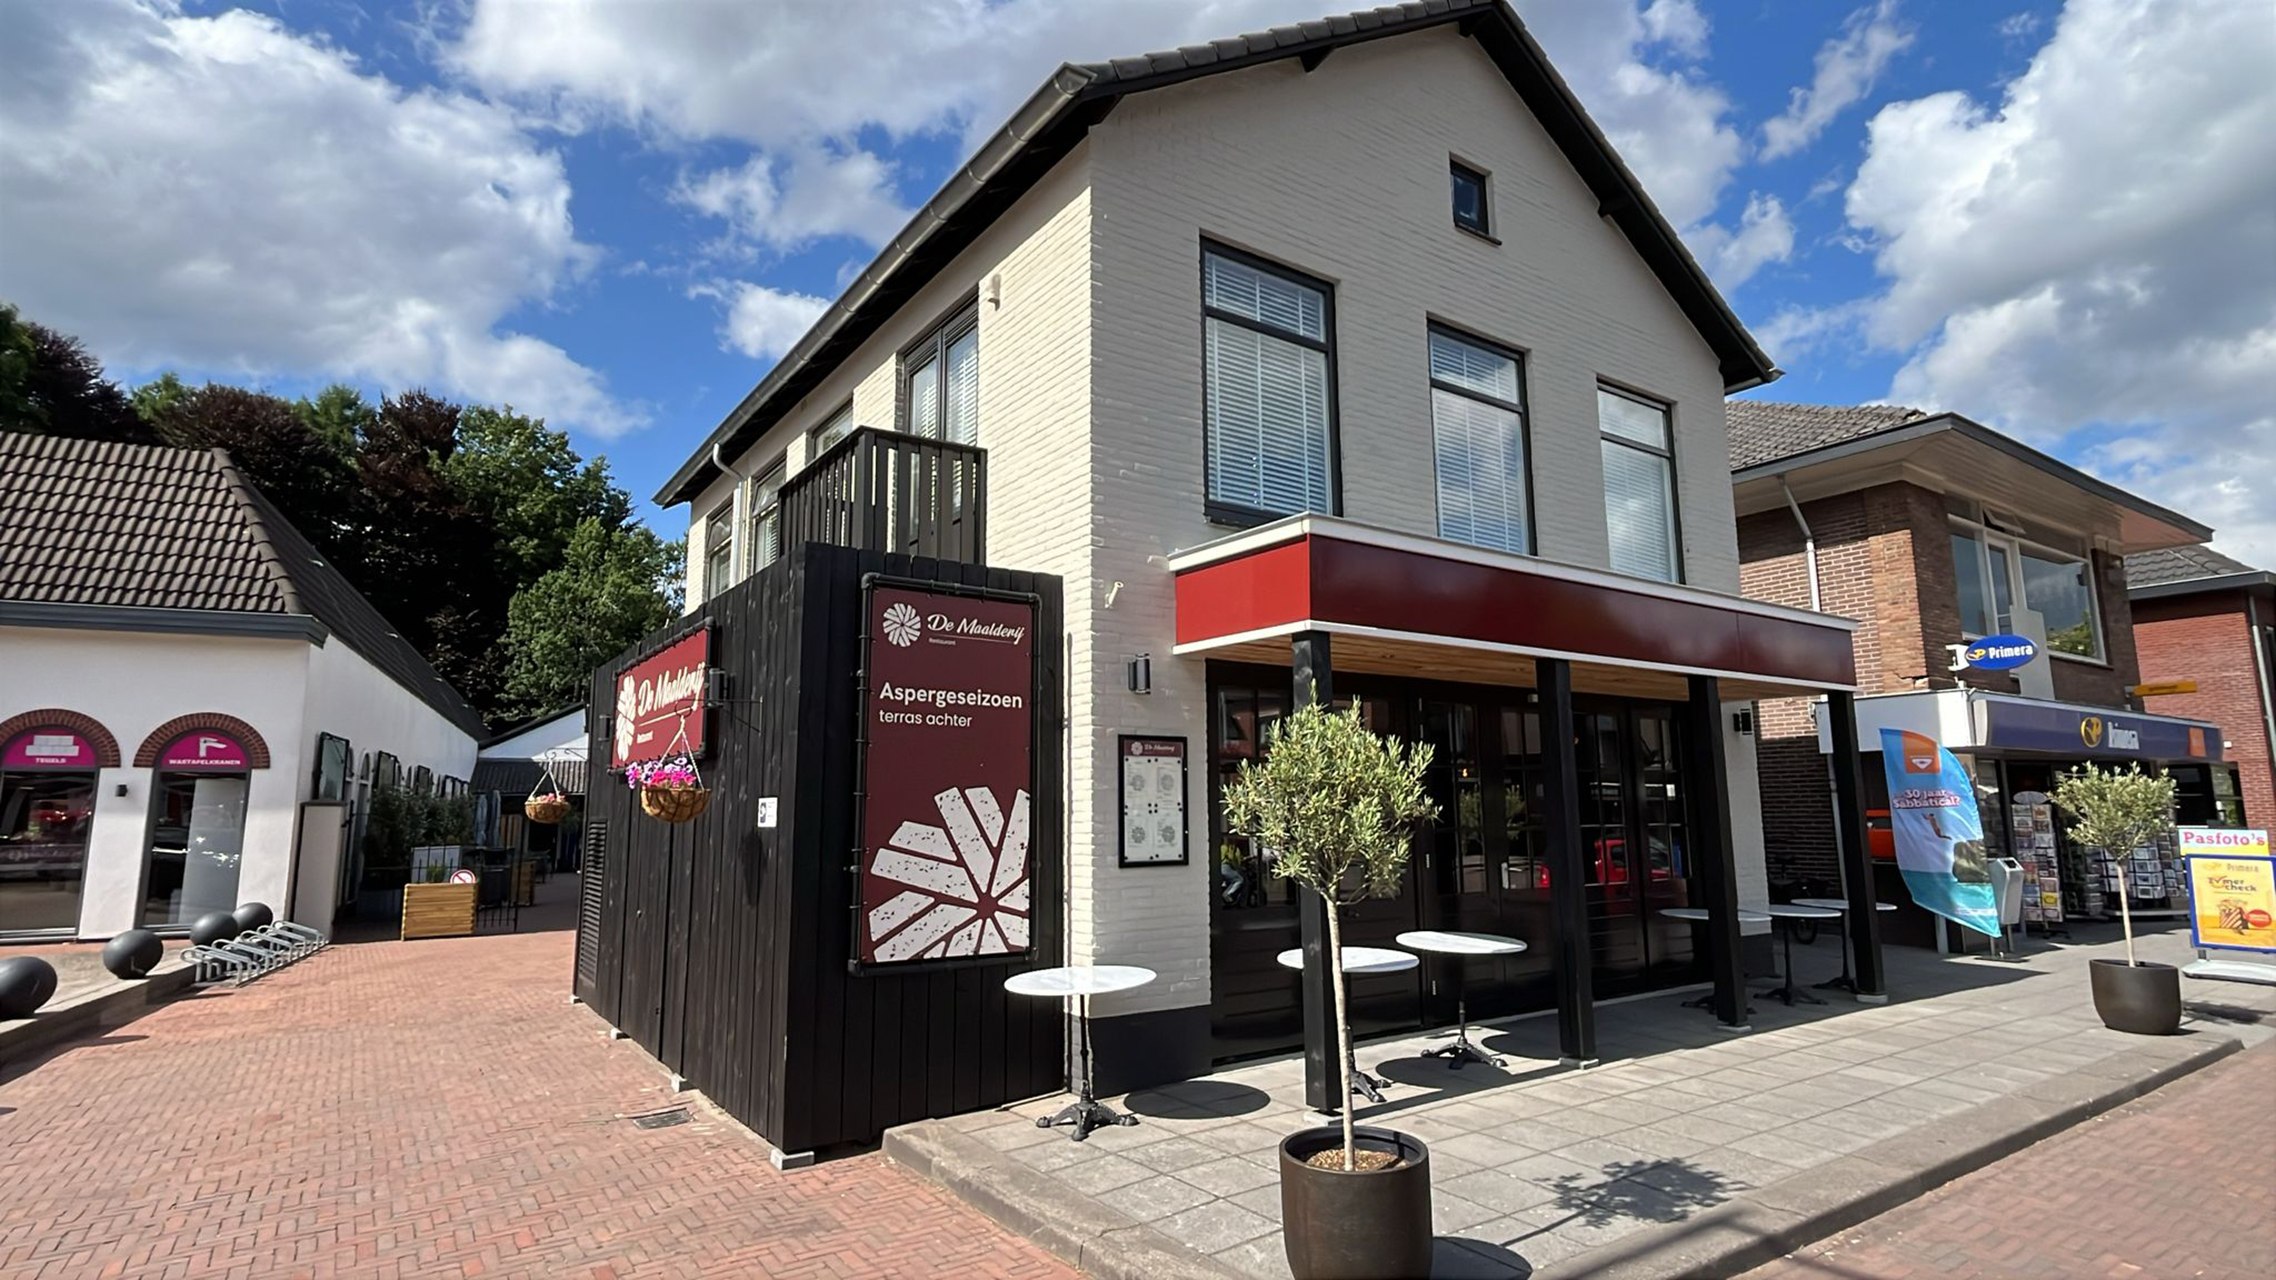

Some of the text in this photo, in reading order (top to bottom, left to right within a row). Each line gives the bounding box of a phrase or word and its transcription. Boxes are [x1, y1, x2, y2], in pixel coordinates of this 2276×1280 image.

[927, 613, 1025, 645] De Maalderij
[1988, 645, 2034, 659] Primera
[637, 661, 706, 717] De Maalderij
[879, 681, 1023, 709] Aspergeseizoen
[879, 709, 973, 728] terras achter
[1904, 789, 1920, 799] 30
[2183, 831, 2266, 846] Pasfoto's
